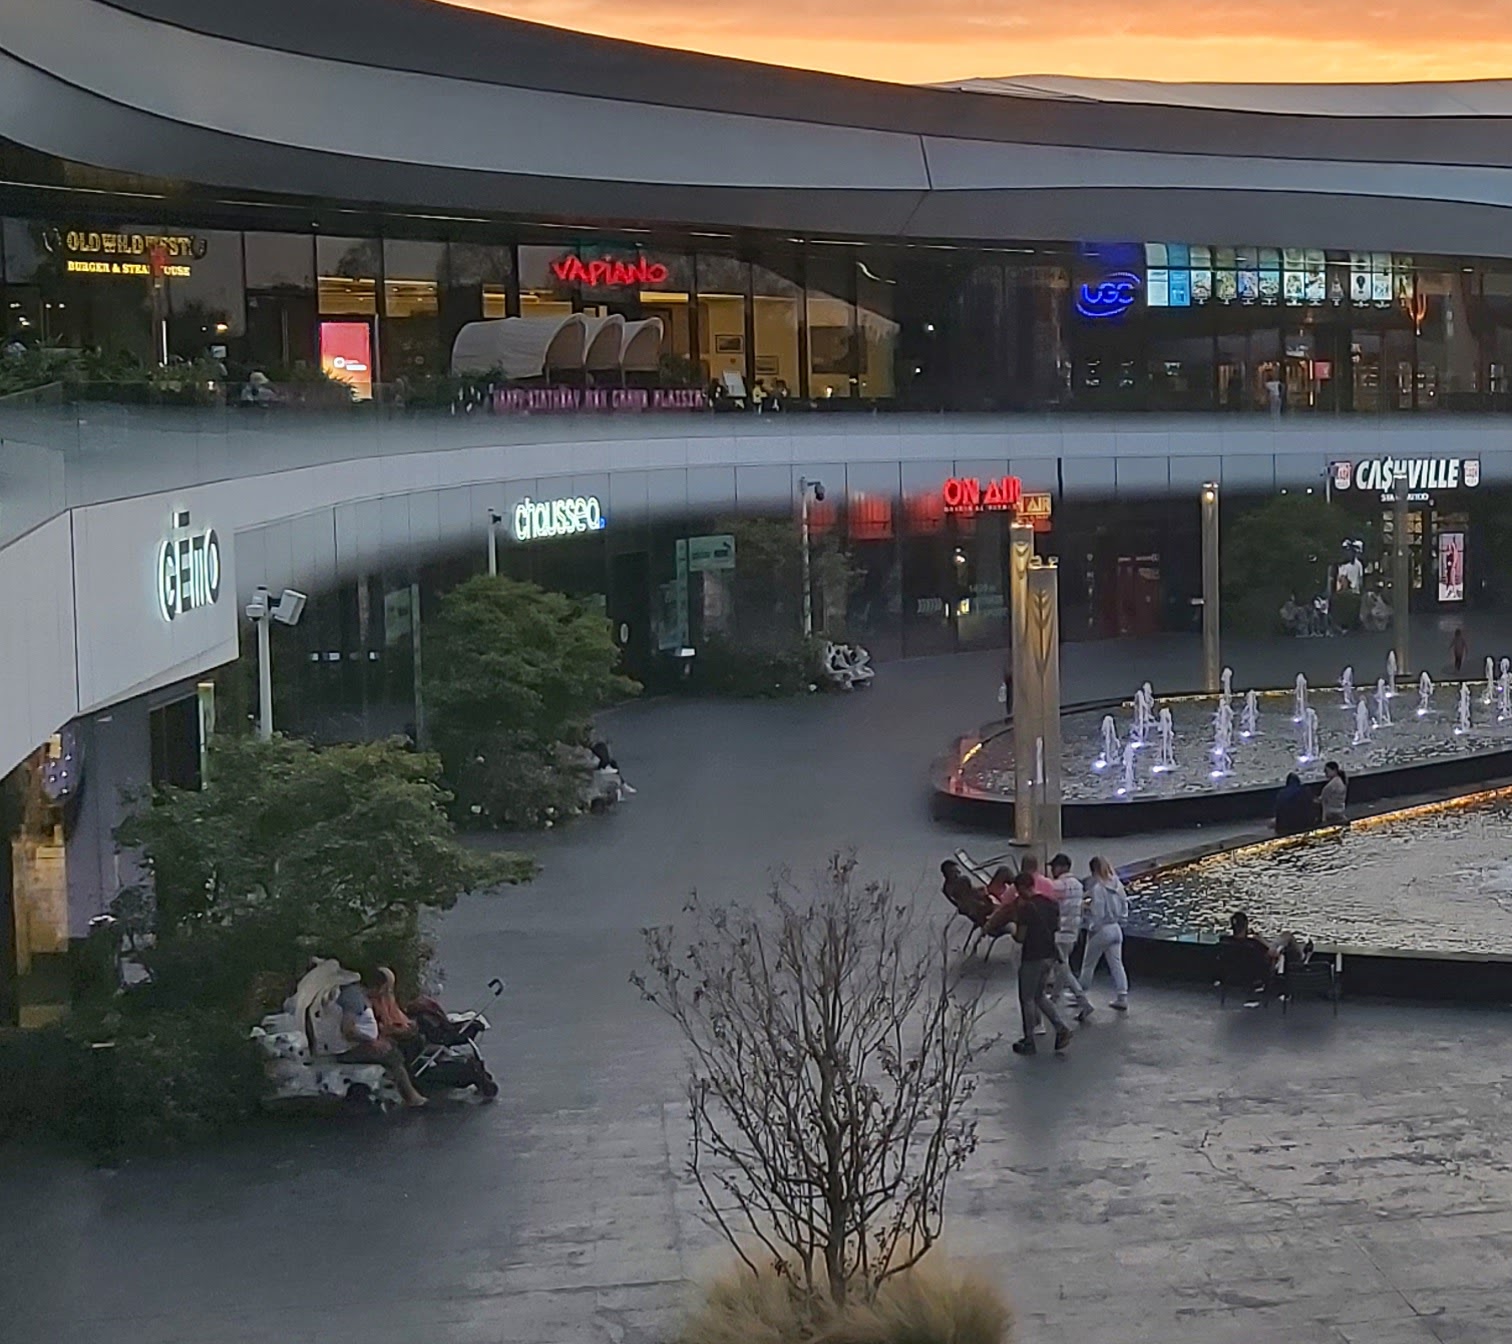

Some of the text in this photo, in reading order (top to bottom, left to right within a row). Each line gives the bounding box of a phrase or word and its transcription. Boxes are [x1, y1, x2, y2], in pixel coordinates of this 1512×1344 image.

[67, 231, 100, 252] OLD
[101, 233, 144, 255] WILD
[67, 260, 110, 273] BURGER
[122, 263, 190, 277] STEAOUSE
[1082, 282, 1135, 304] UGC
[944, 478, 980, 505] ON
